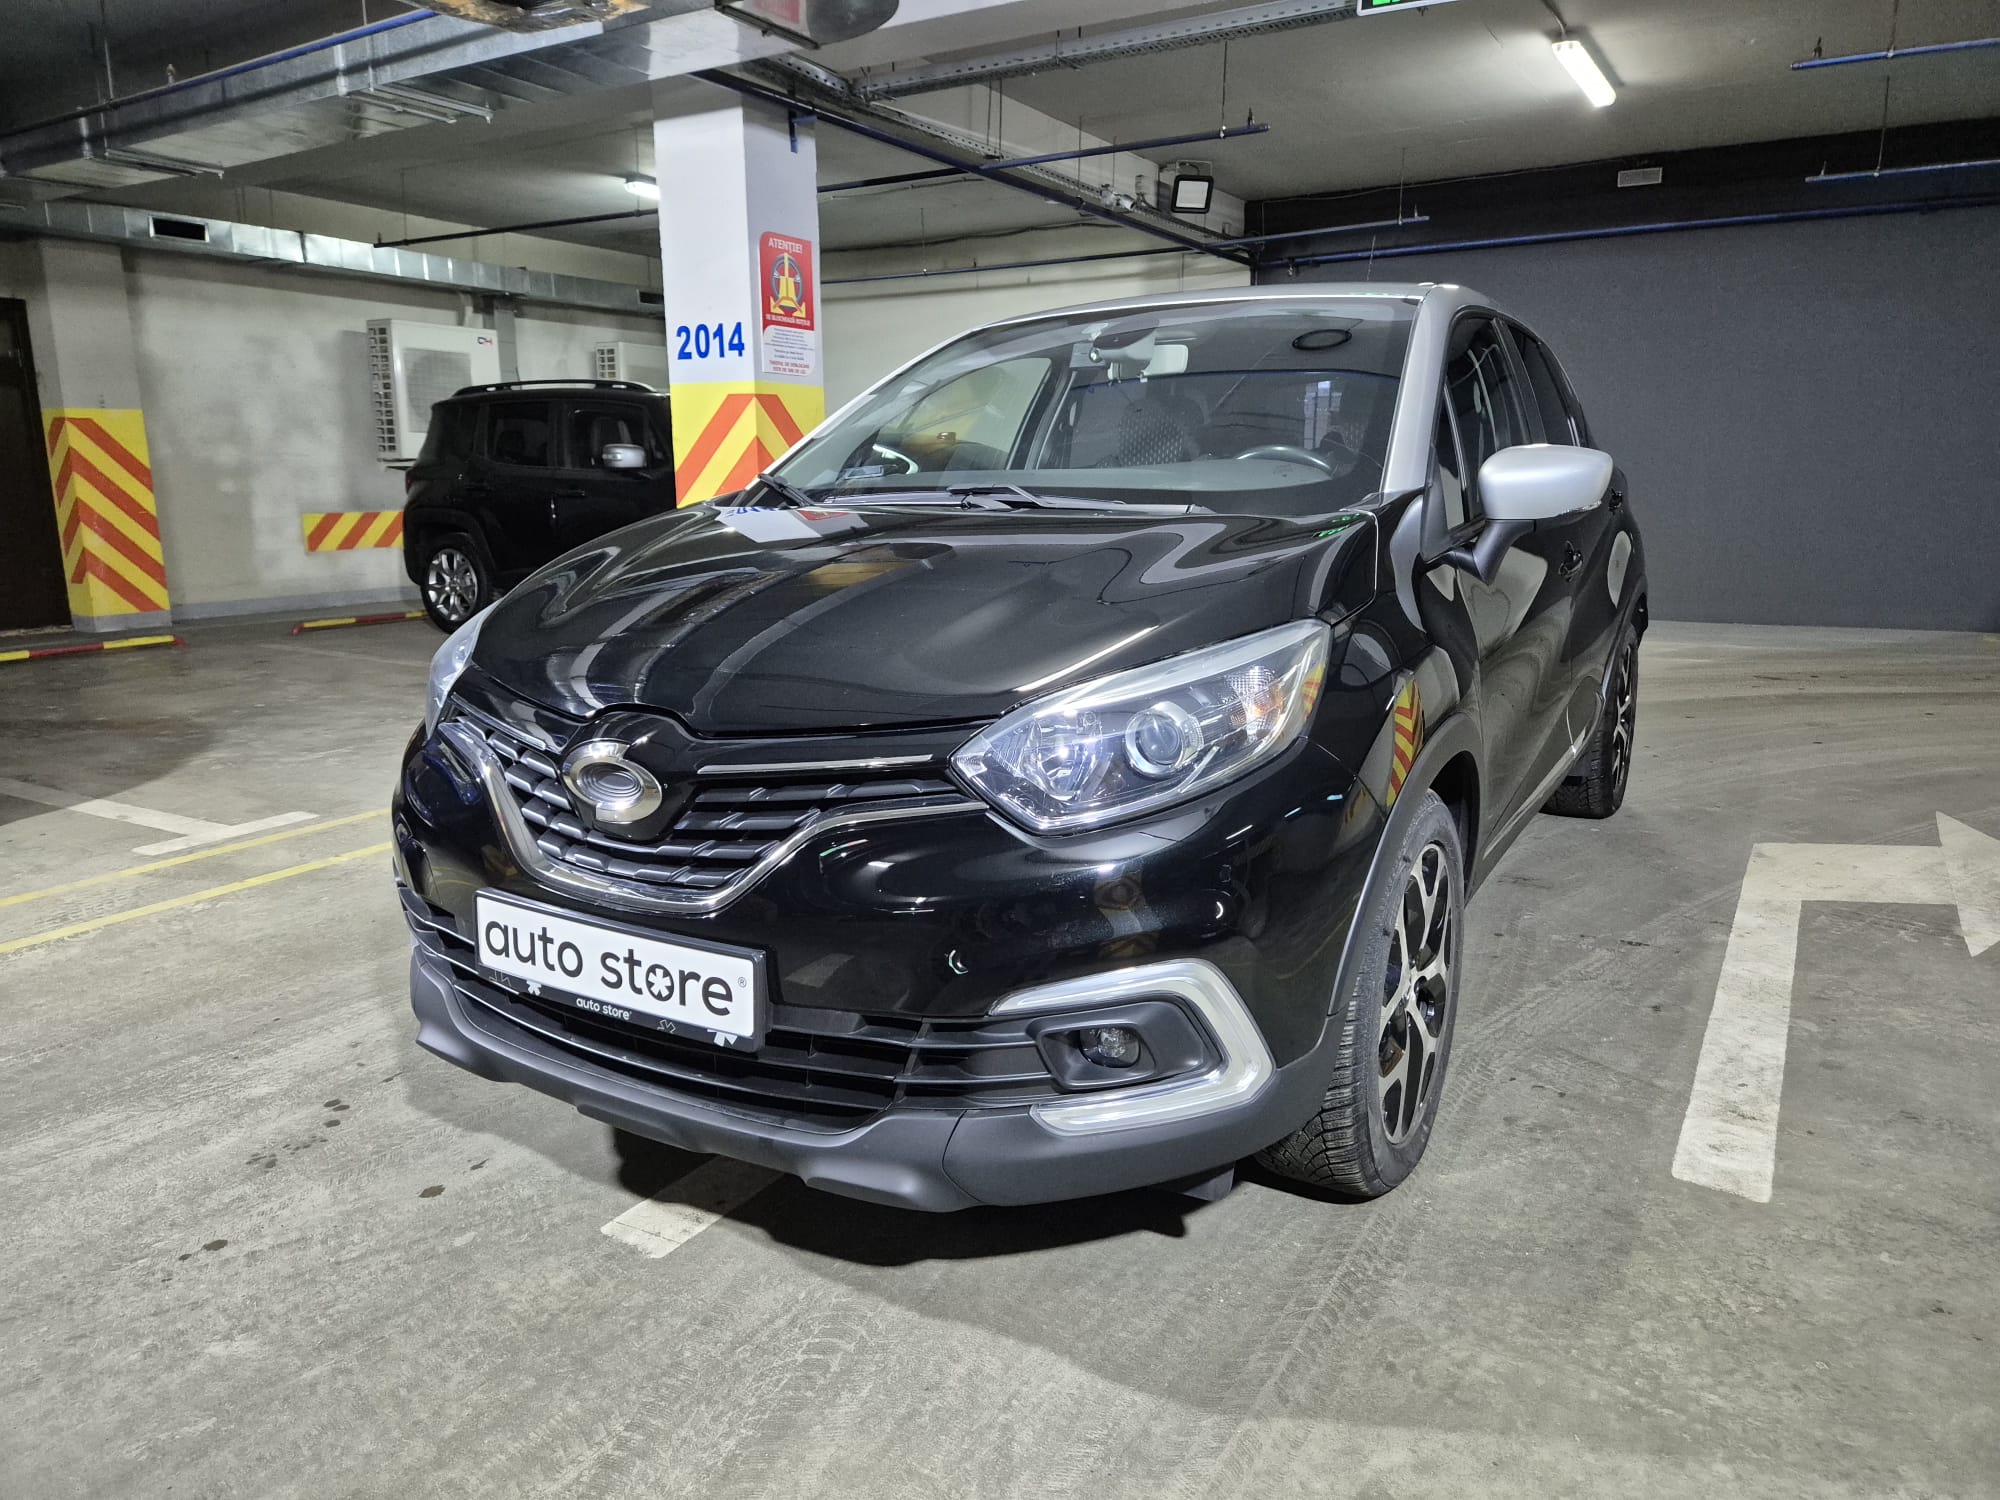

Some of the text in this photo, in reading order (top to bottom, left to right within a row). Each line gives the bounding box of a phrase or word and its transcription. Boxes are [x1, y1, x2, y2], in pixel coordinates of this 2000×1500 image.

[676, 321, 745, 360] 2014
[485, 920, 584, 978] auto
[576, 998, 600, 1012] auto
